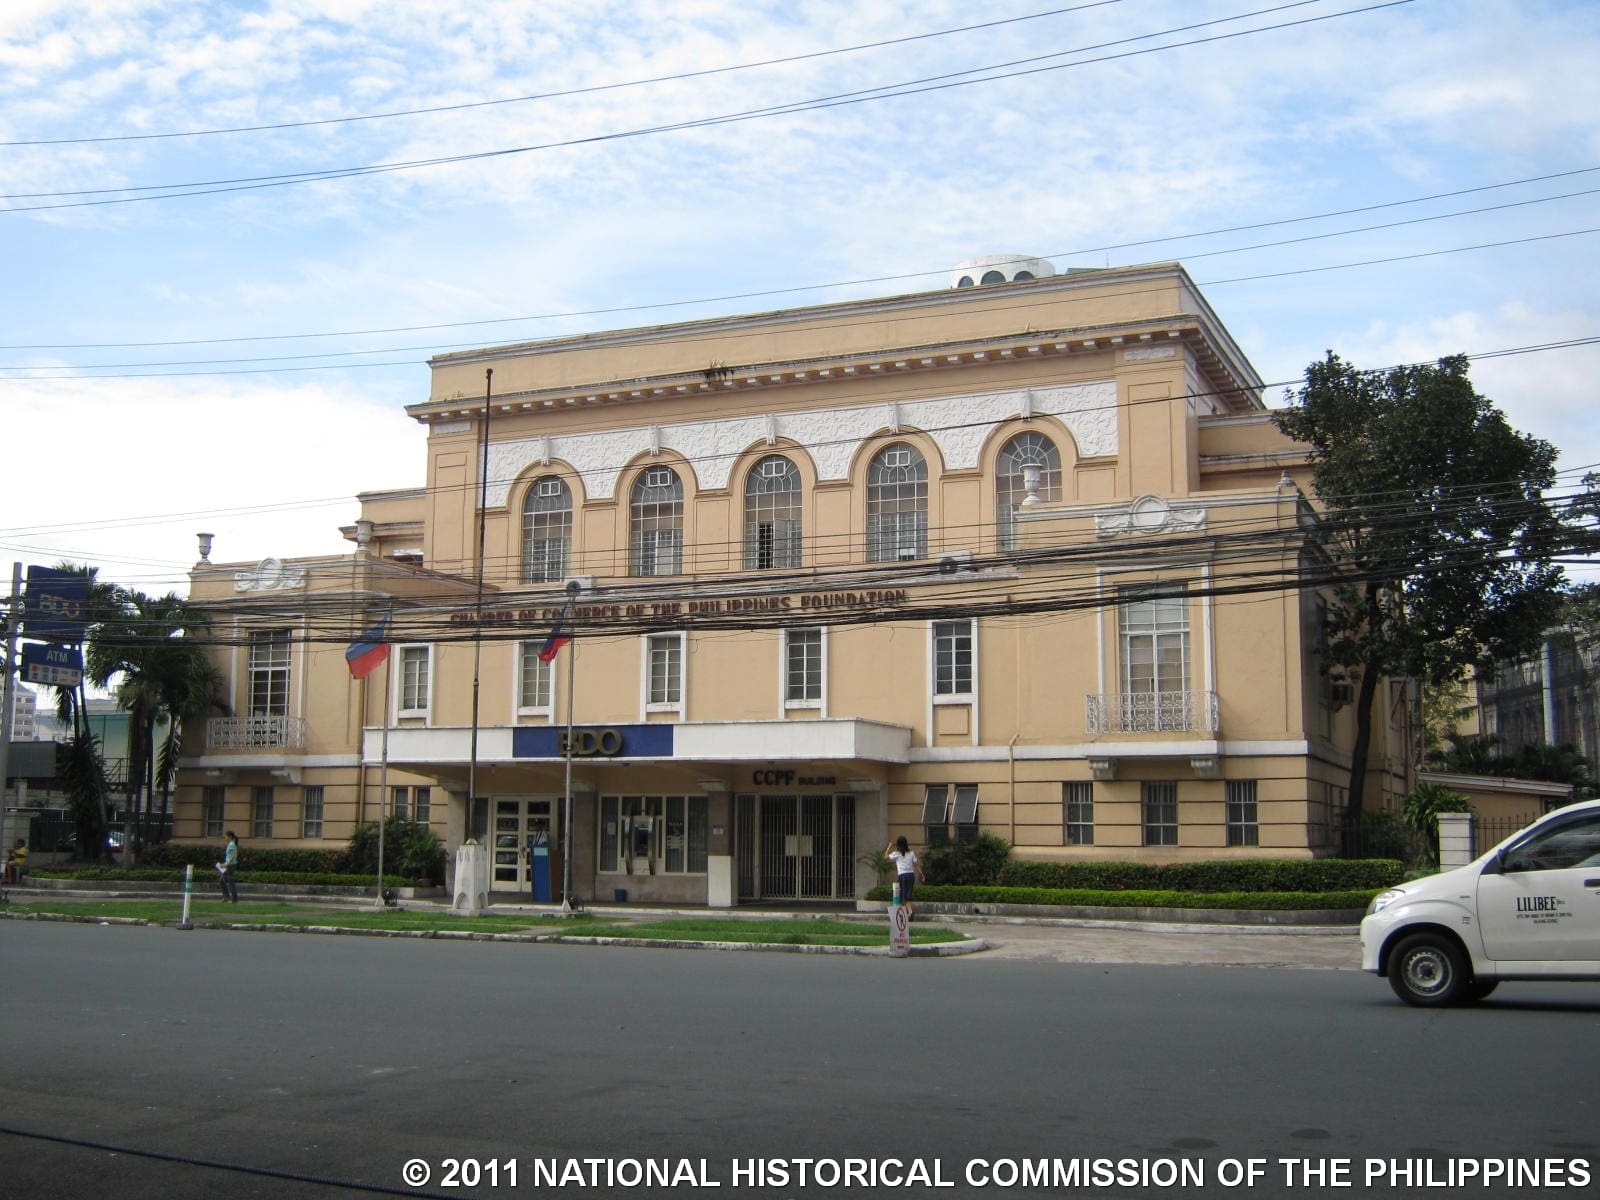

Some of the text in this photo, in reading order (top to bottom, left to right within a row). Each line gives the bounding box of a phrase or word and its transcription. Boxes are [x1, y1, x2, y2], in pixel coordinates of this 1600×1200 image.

[688, 596, 791, 614] PHILIPPINES
[800, 589, 906, 608] FOUNDATION
[46, 649, 68, 663] ATM
[558, 728, 623, 756] BDO
[752, 769, 796, 786] CCPF
[1517, 896, 1557, 912] LILIBEE
